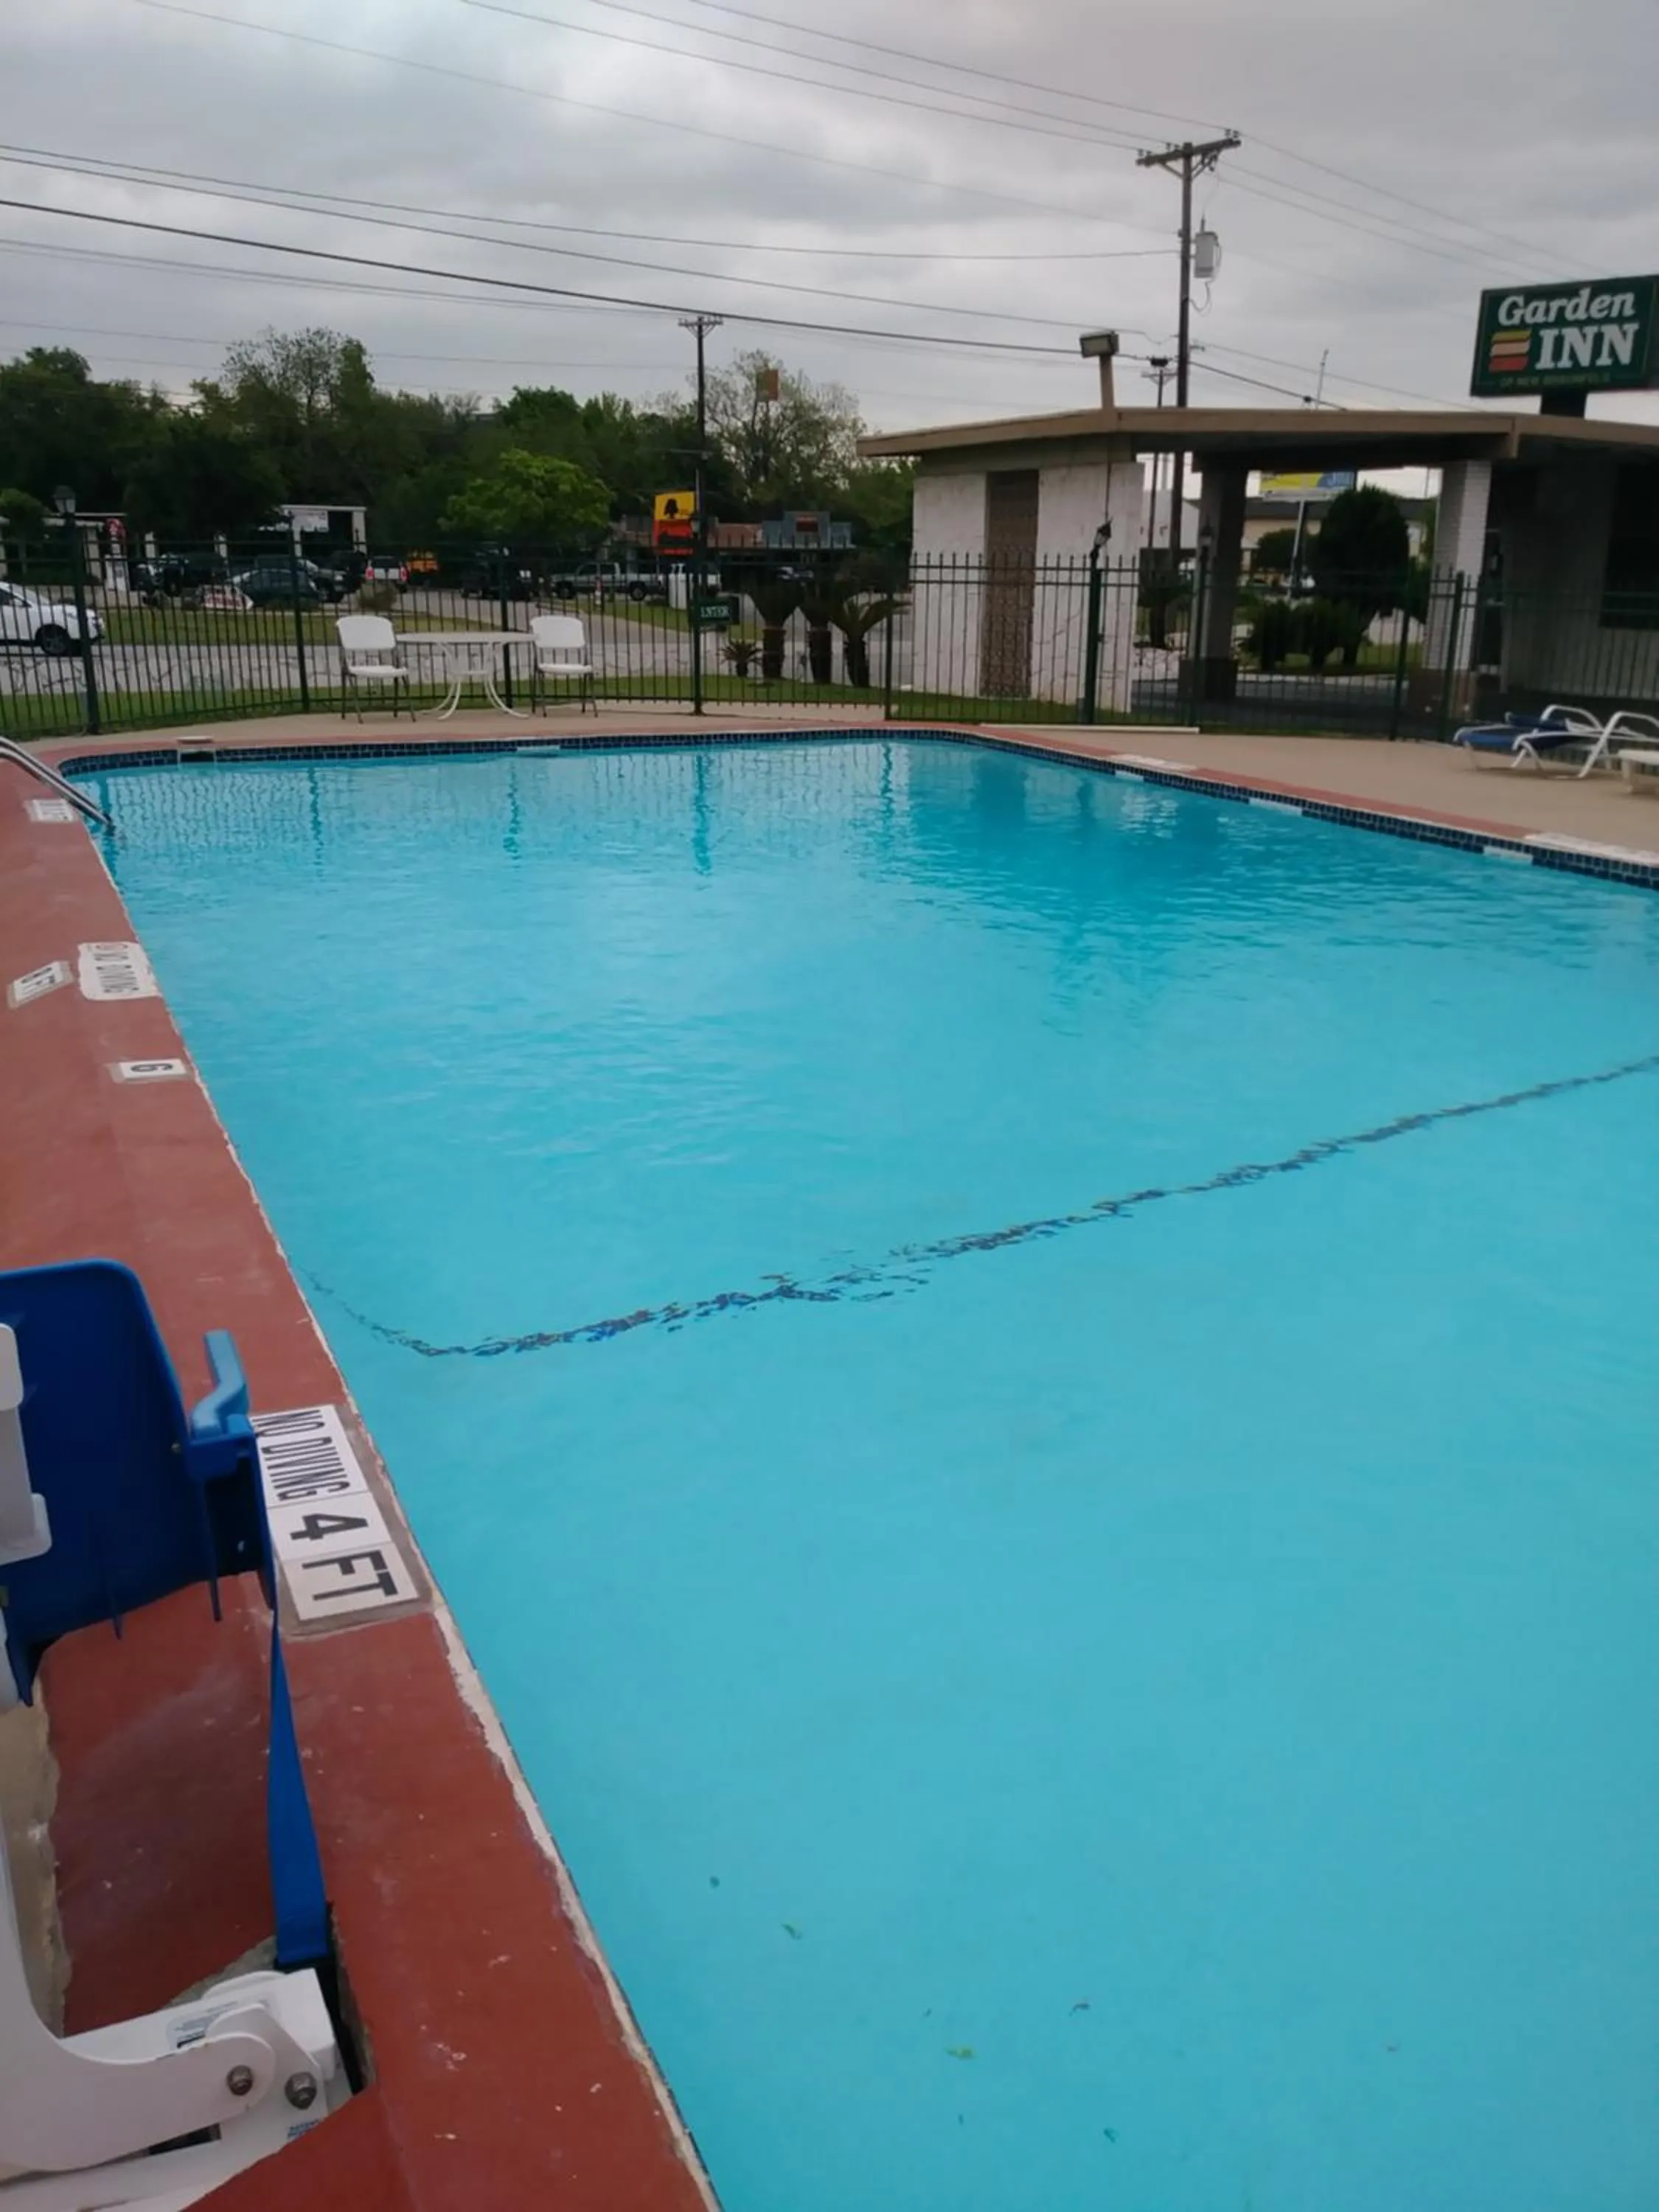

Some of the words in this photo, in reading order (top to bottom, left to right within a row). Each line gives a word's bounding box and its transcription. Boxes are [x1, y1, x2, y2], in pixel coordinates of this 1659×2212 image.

[1498, 287, 1636, 326] Garden
[1534, 323, 1640, 371] INN
[251, 1409, 325, 1438] NO
[261, 1436, 351, 1501] DIVING
[289, 1514, 369, 1540] 4
[302, 1549, 399, 1601] FT
